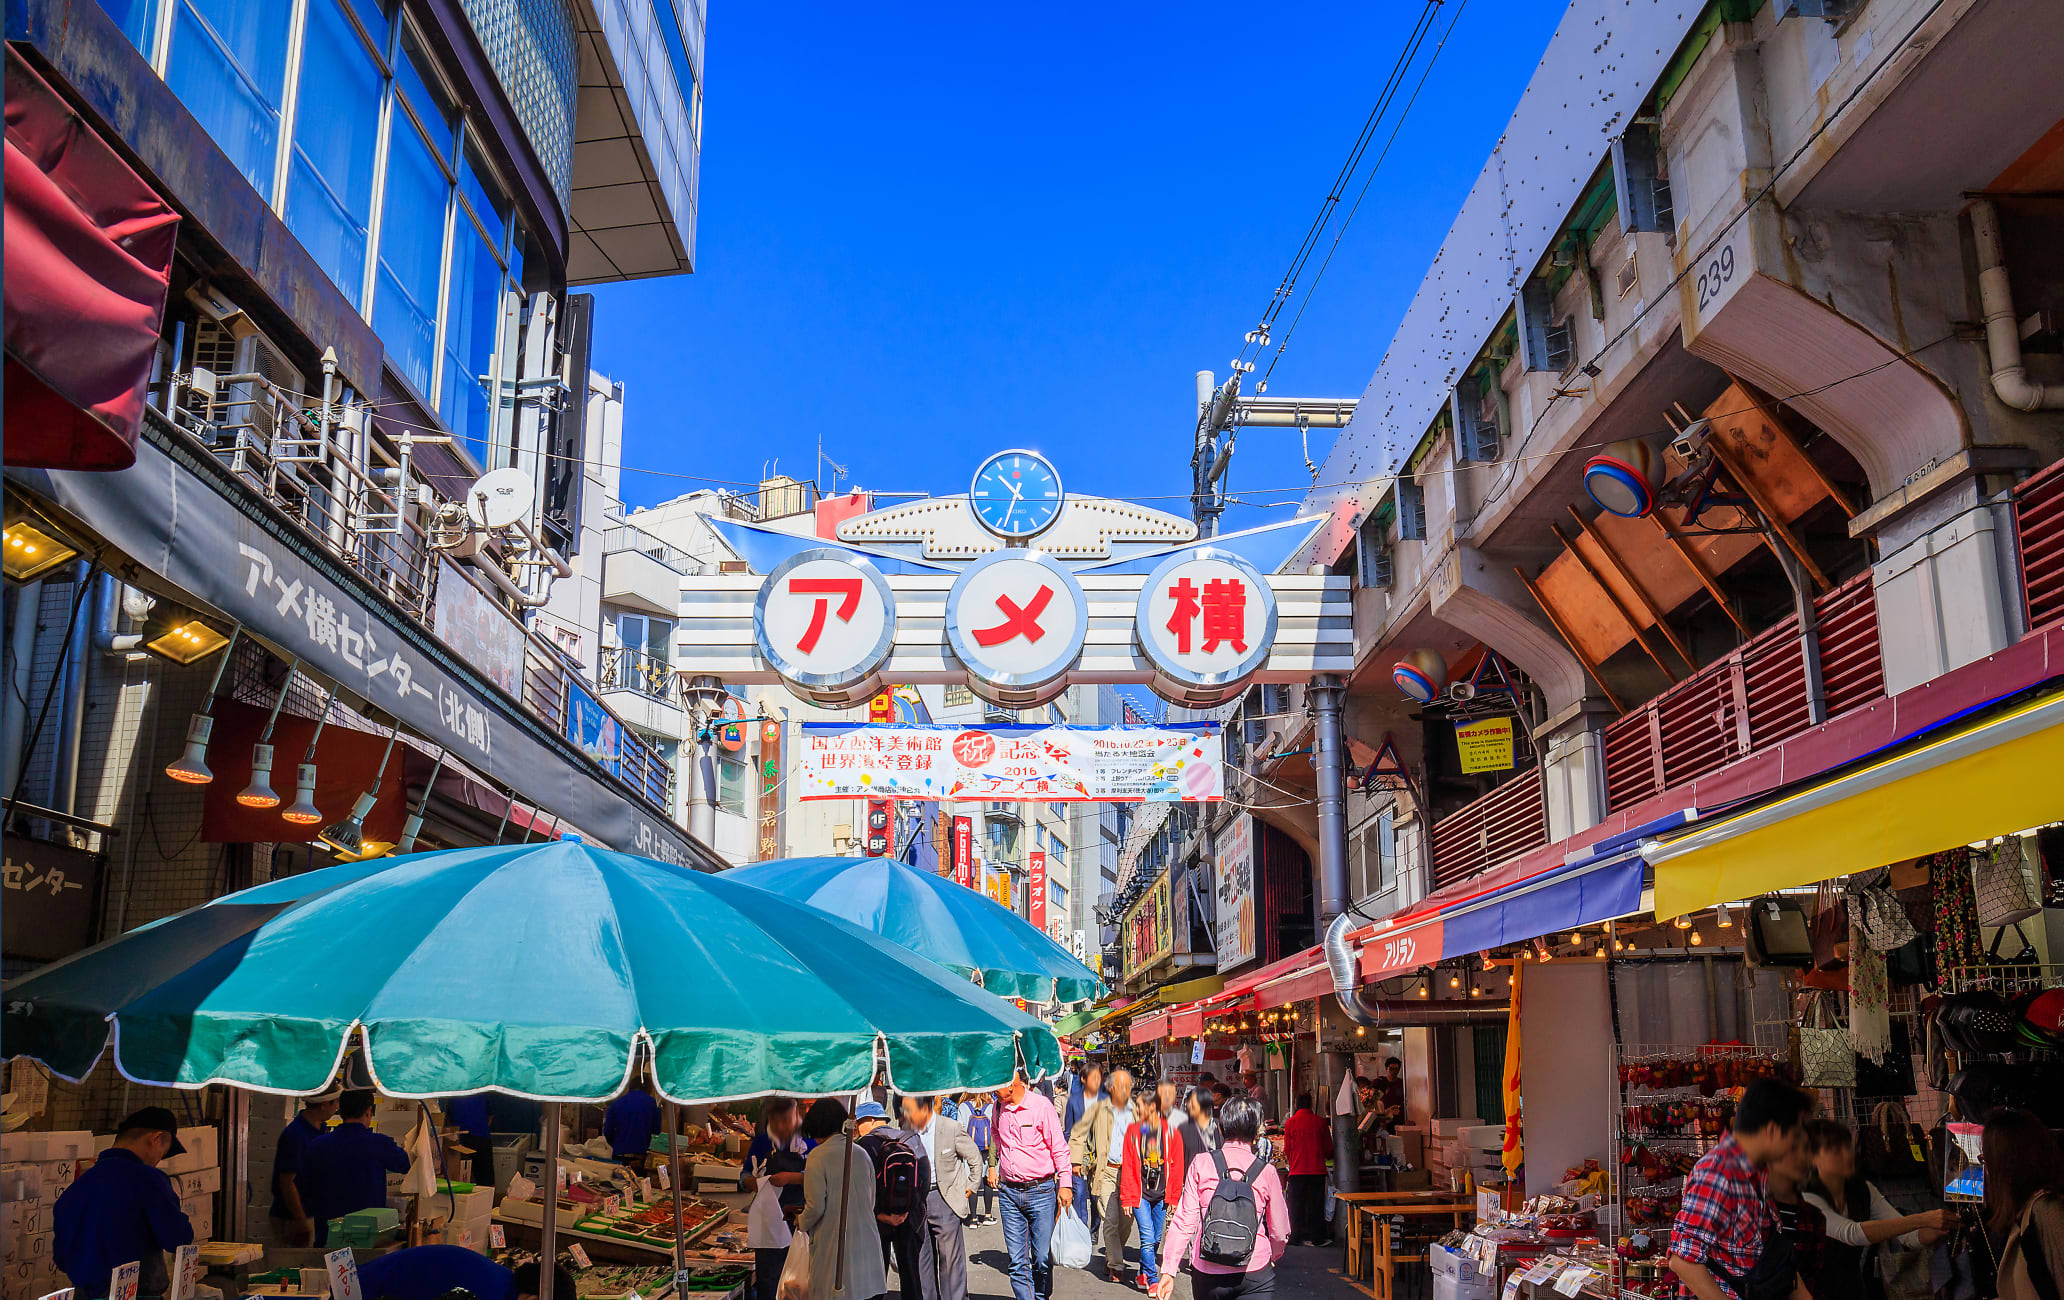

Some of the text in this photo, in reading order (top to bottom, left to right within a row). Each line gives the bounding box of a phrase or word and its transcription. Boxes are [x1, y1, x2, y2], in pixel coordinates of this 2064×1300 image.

[1697, 244, 1735, 313] 239
[789, 577, 1248, 656] アメ横
[812, 735, 942, 752] 国立西洋美術館
[961, 736, 988, 762] 祝
[1004, 766, 1037, 776] 2016
[989, 780, 1049, 793] アメ横
[871, 813, 886, 825] 1F
[869, 838, 887, 850] BF
[1031, 859, 1045, 911] カラオケ
[1382, 936, 1416, 969] アリラン
